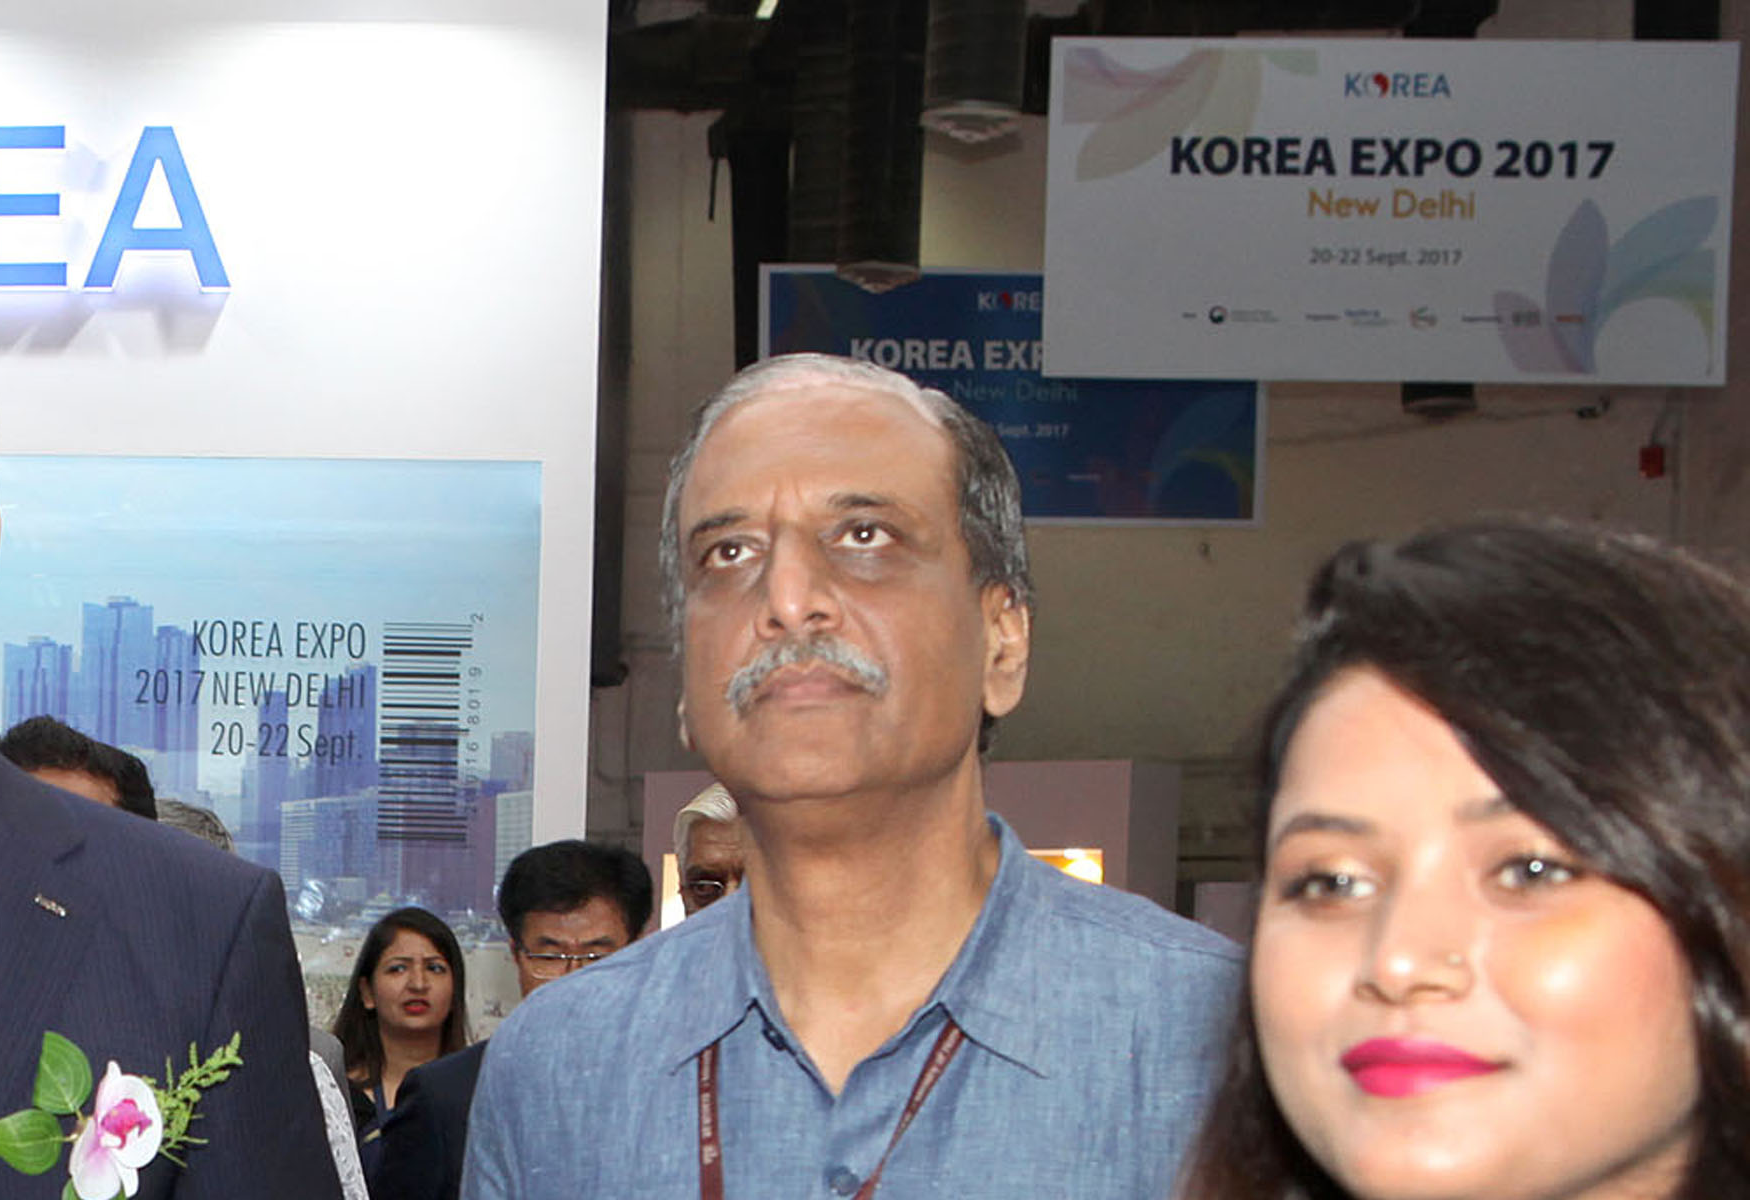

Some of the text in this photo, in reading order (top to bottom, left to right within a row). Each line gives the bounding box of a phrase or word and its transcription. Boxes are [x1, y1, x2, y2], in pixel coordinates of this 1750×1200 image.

[1344, 71, 1451, 98] KOREA
[1169, 136, 1616, 179] KOREA EXPO 2017
[1307, 188, 1476, 219] New Delhi
[1309, 246, 1361, 266] 20-22
[1417, 247, 1463, 266] 2017
[850, 338, 975, 372] KOREA
[192, 619, 367, 660] KOREA EXPO
[135, 668, 365, 709] 2017 NEW DELHI
[210, 721, 363, 766] 20-22 Sept.
